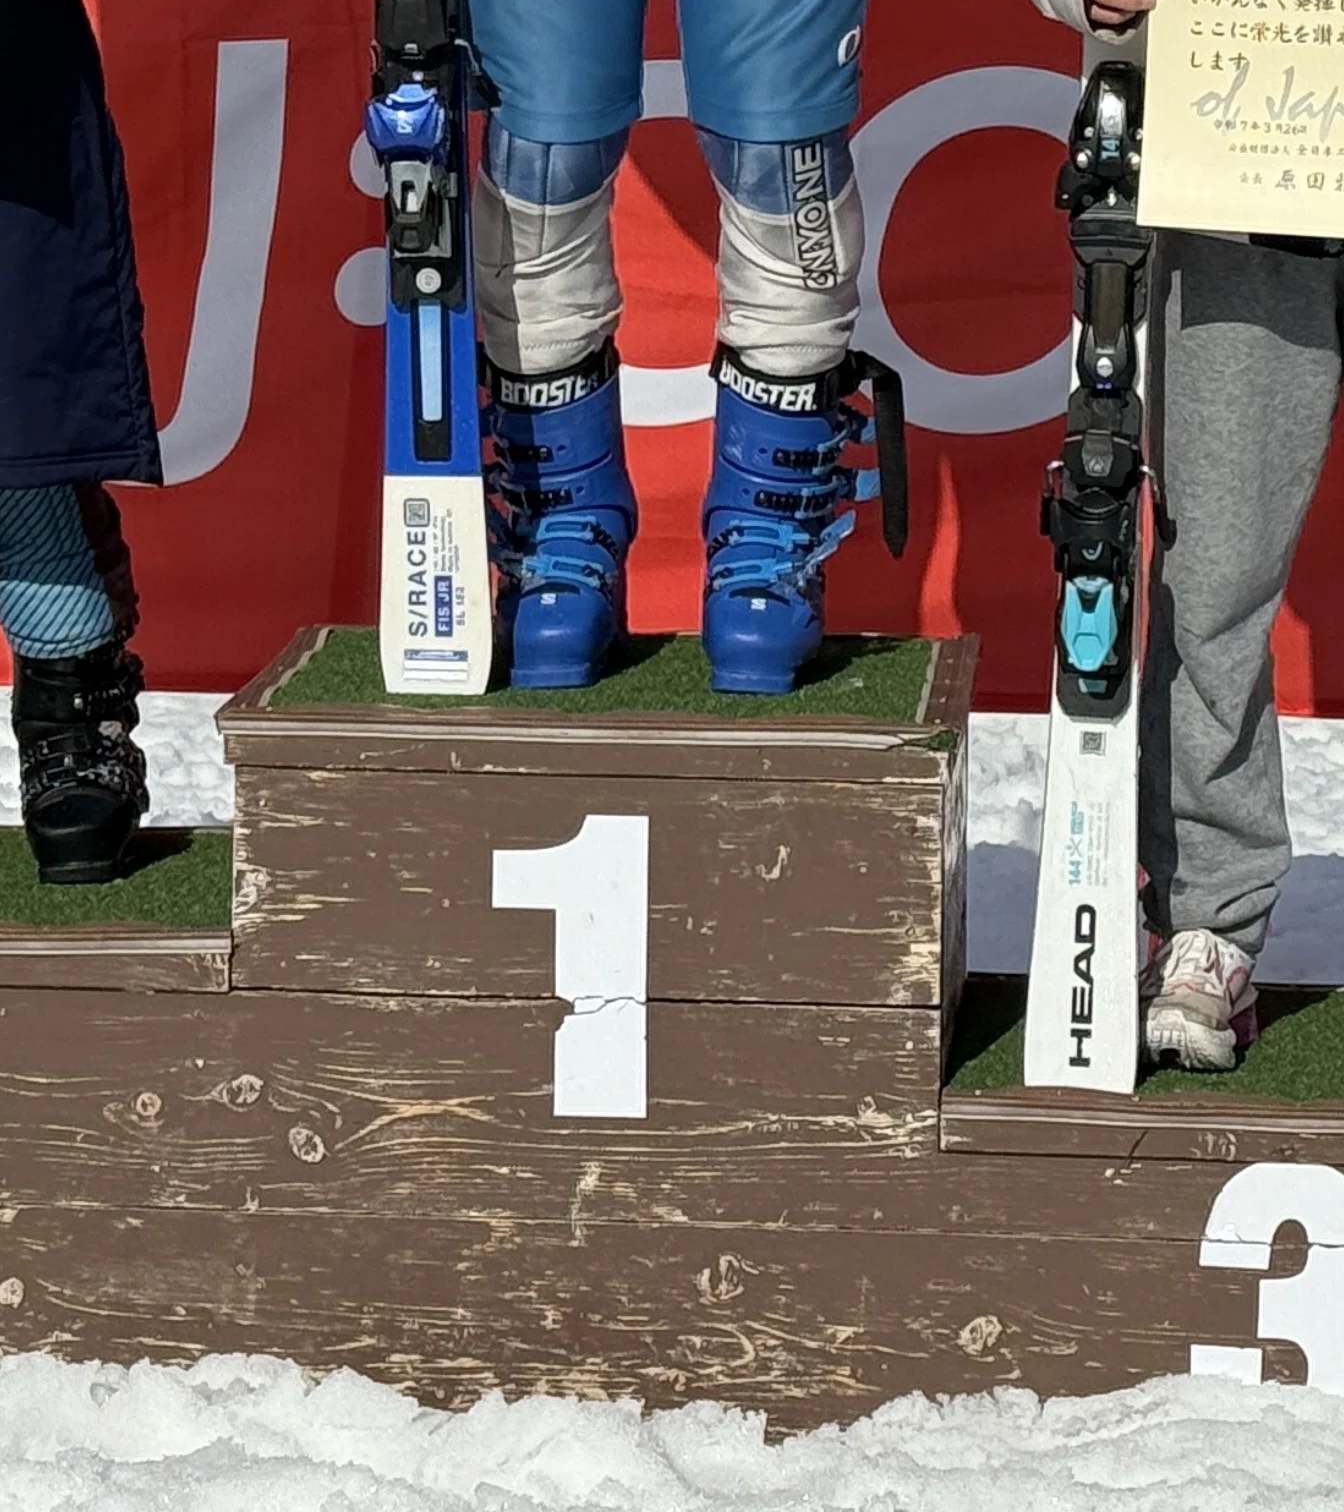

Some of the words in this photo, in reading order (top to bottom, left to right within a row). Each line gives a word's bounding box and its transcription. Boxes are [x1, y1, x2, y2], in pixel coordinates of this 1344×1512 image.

[407, 530, 428, 638] S/RACE
[438, 580, 451, 603] JR
[438, 608, 451, 632] FIS
[490, 815, 648, 1119] 1
[1069, 903, 1097, 1068] HEAD
